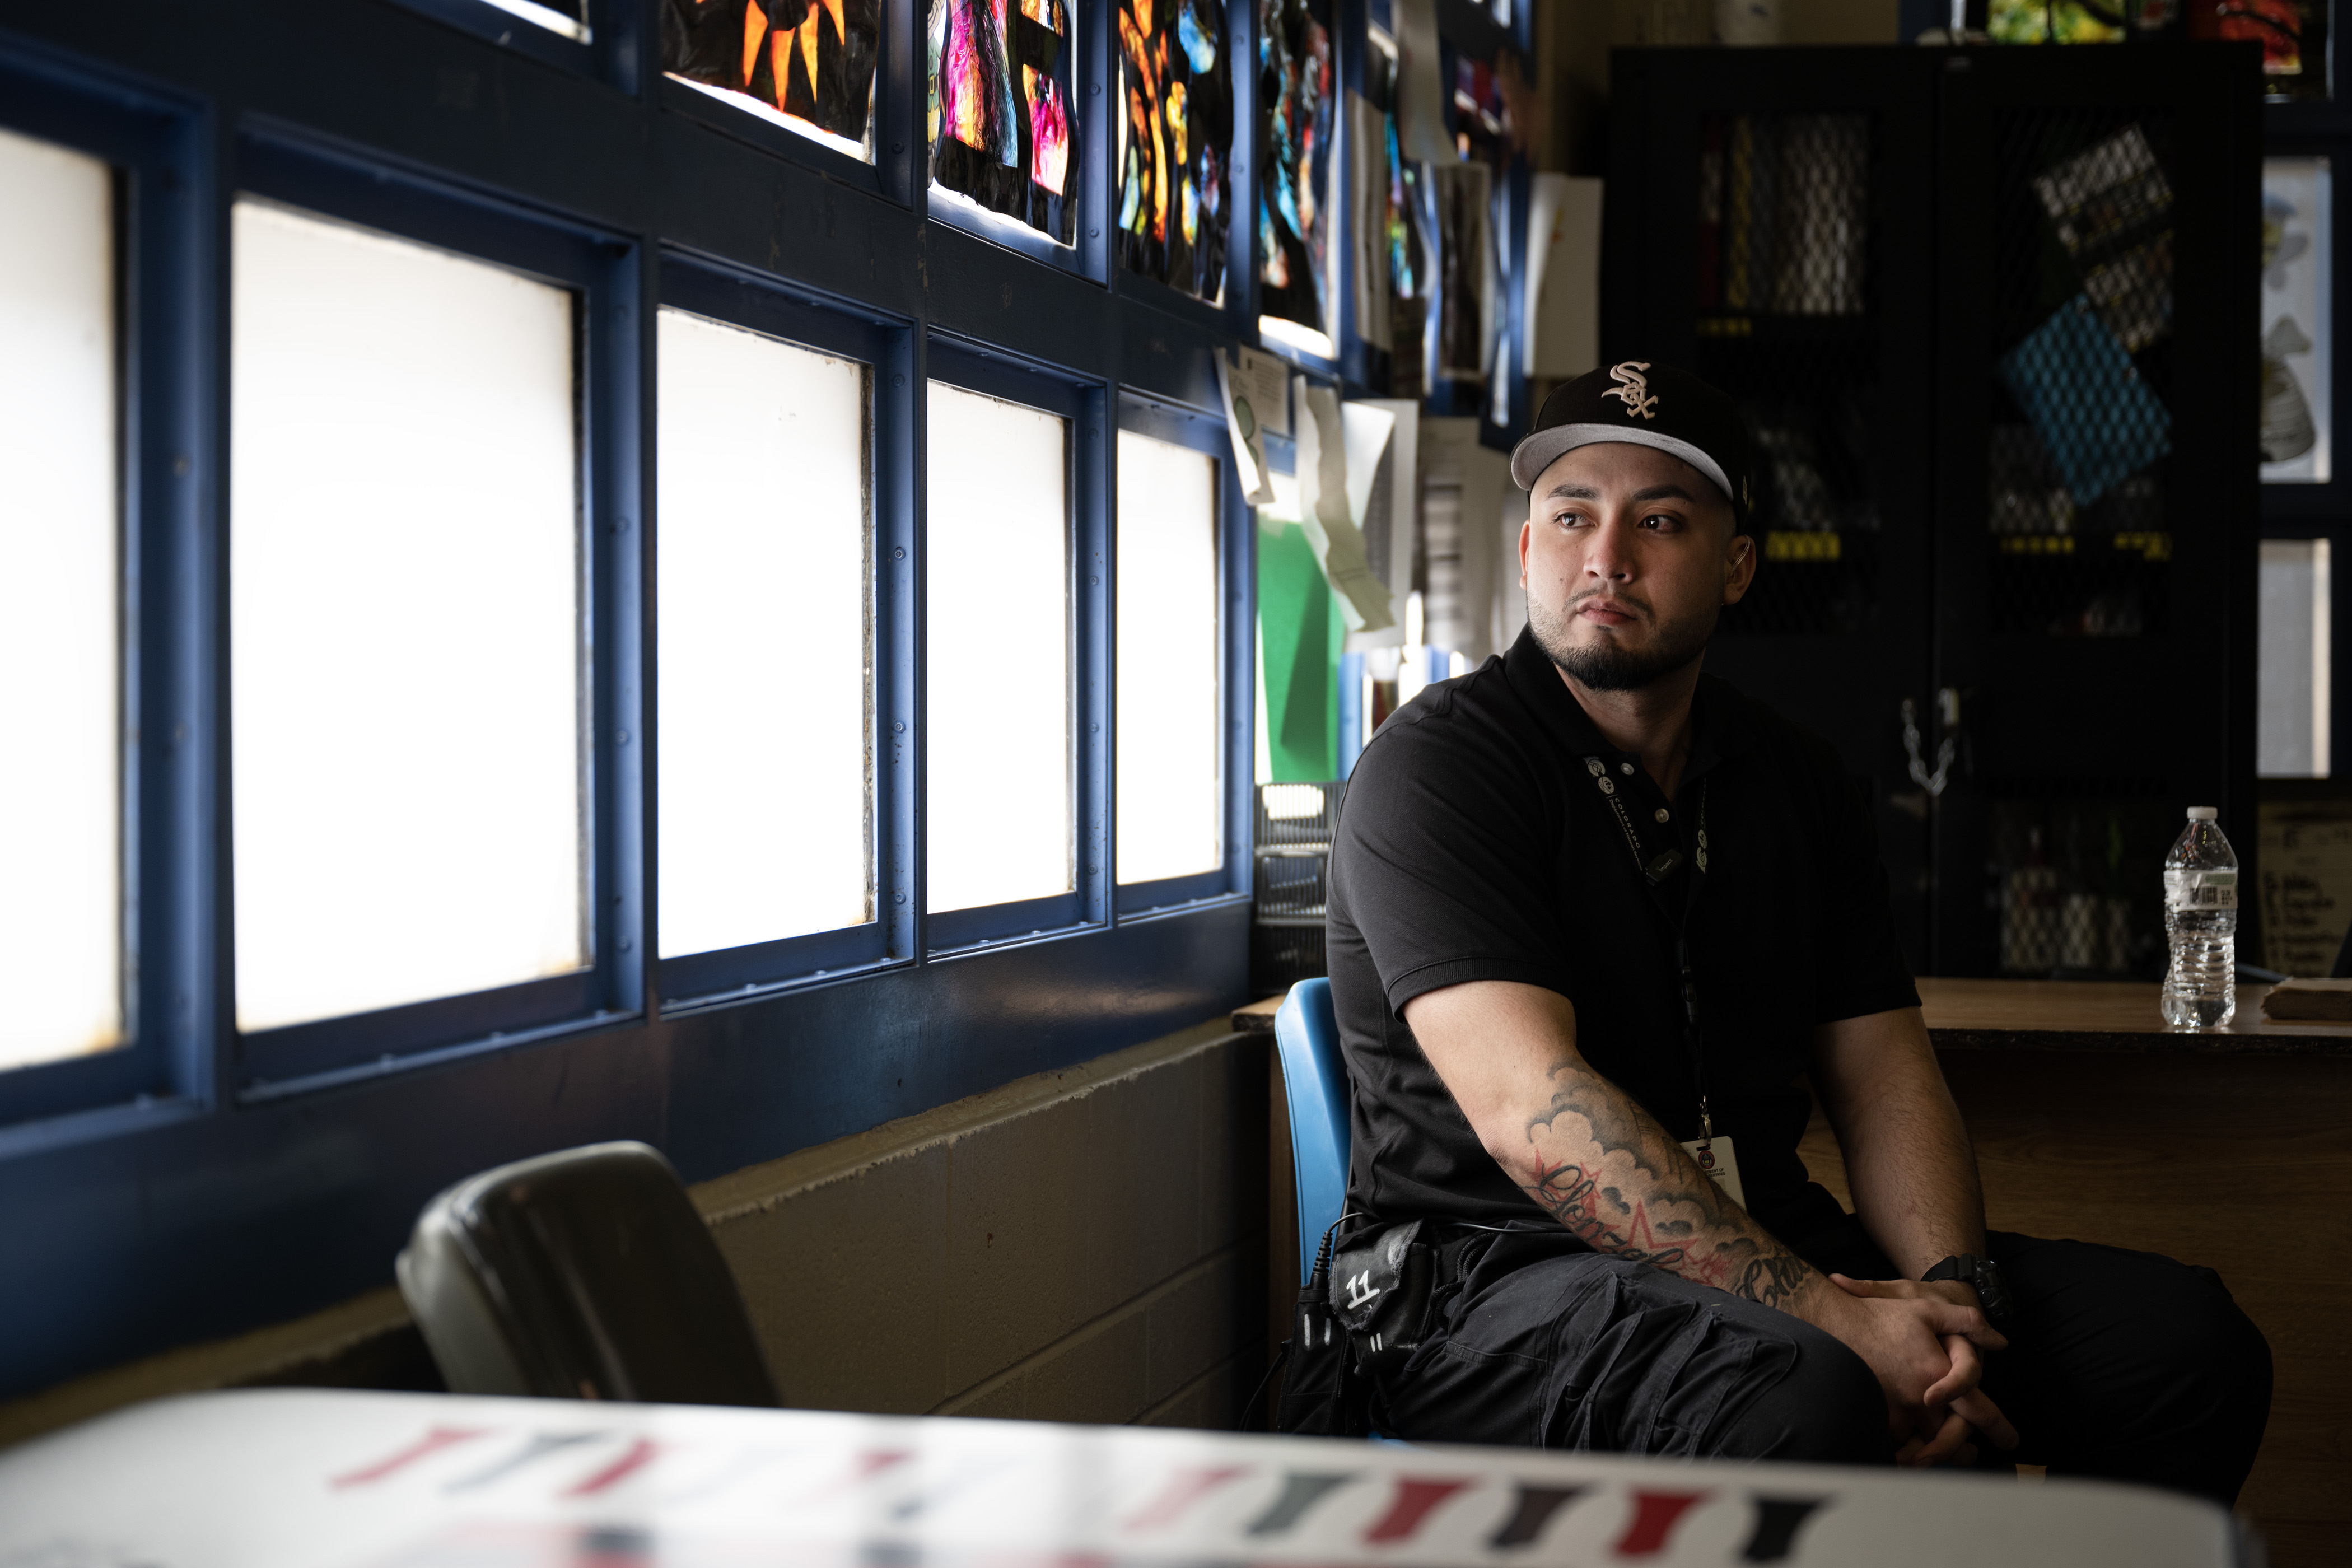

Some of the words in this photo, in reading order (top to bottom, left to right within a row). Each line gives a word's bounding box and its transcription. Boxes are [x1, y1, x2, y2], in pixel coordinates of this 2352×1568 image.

[1609, 799, 1625, 827] Department
[1625, 832, 1635, 851] Human
[1614, 797, 1640, 849] COLORADO
[1346, 1269, 1380, 1310] 11
